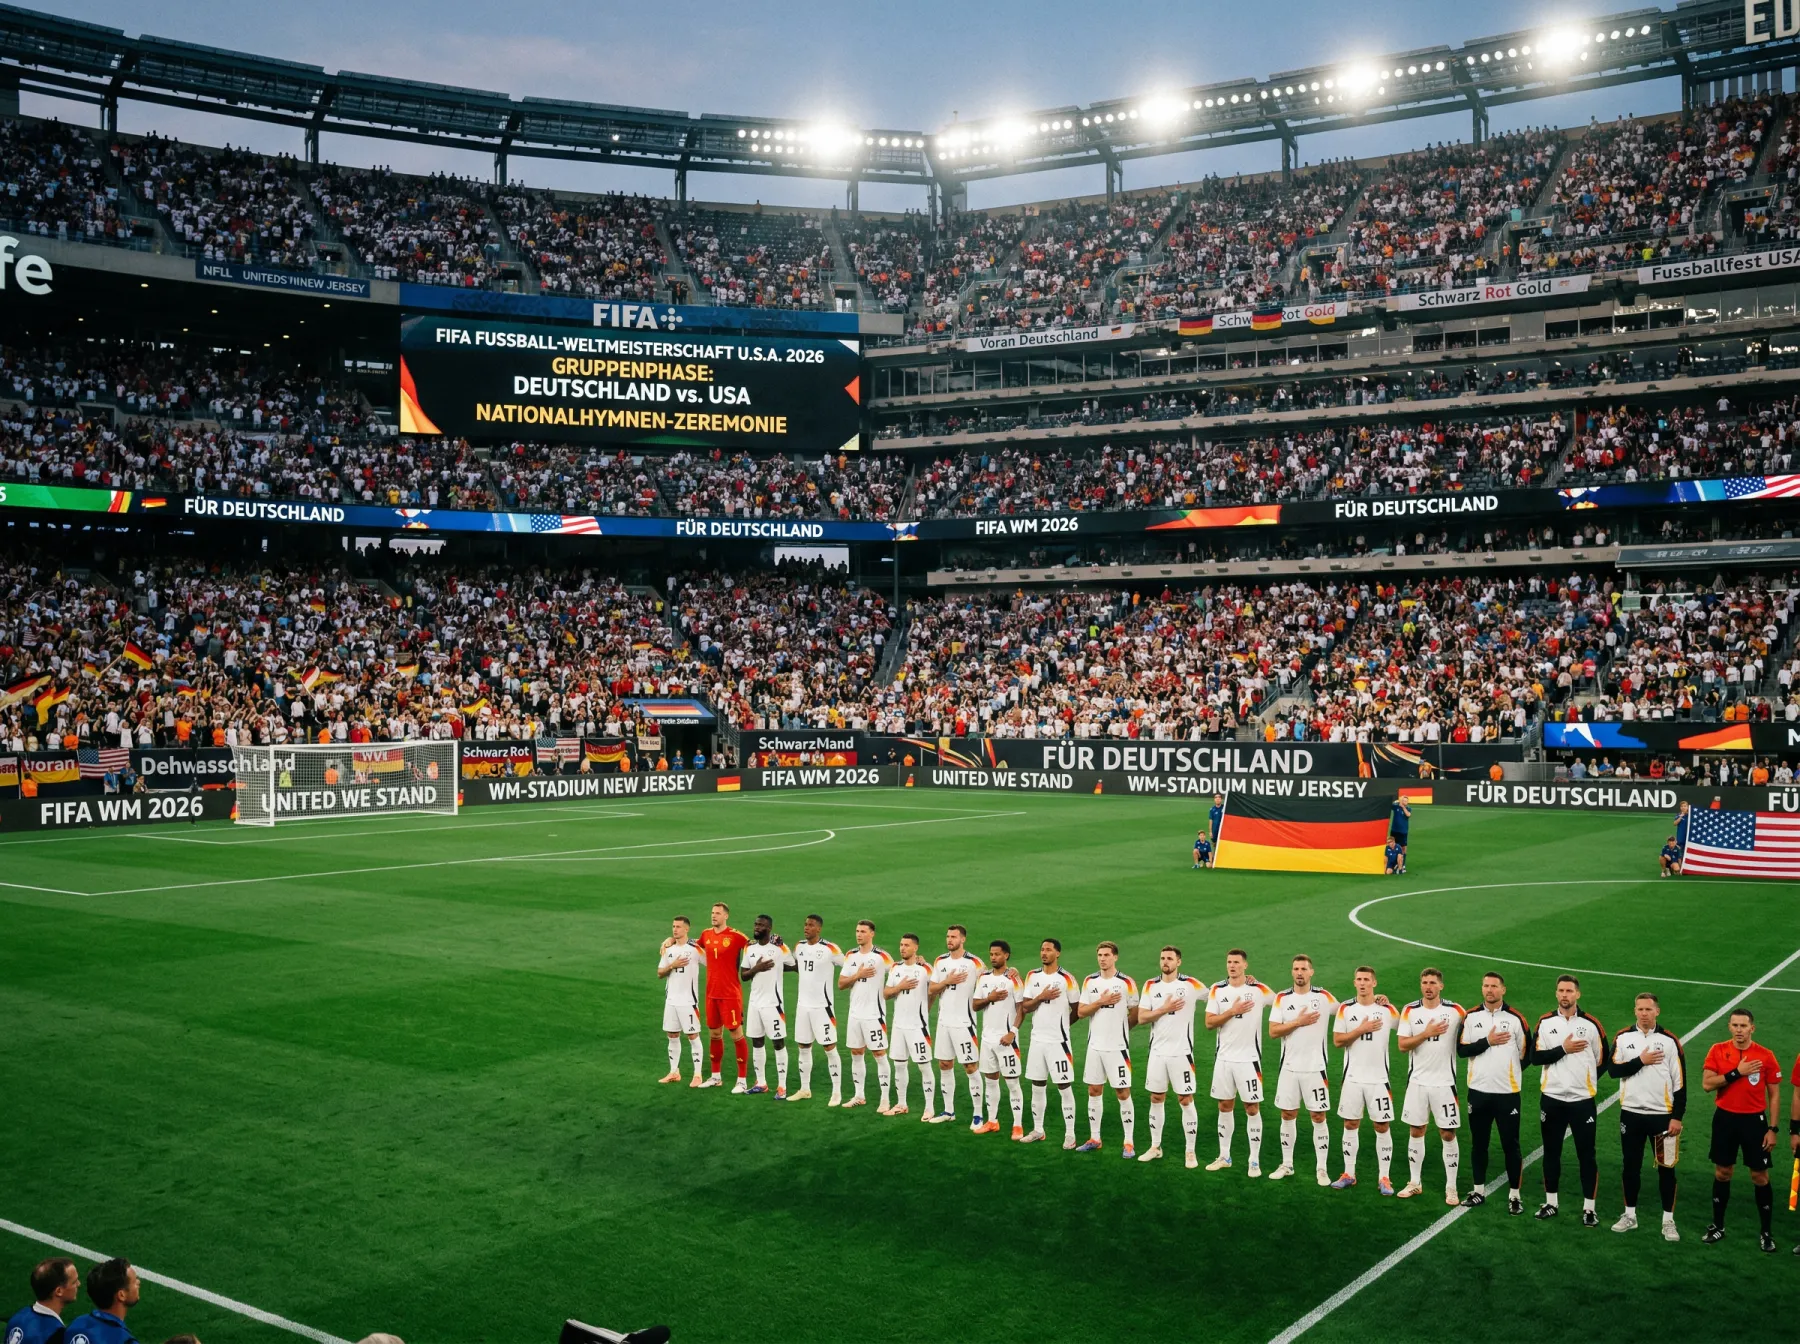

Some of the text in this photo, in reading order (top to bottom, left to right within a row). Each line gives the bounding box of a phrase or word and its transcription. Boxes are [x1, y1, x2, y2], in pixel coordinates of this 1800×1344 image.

[1652, 255, 1762, 281] Fussballfest
[326, 281, 365, 293] JERSEY
[1418, 279, 1552, 308] Schwarz Rot Gold
[593, 303, 658, 329] FIFA
[1219, 314, 1252, 327] Schw
[1304, 303, 1336, 317] Gold
[435, 327, 825, 364] FIFA FUSSBALL-WELTMEISTERSCHAFT U.S.A. 2026
[980, 328, 1098, 350] Voran Deutschland
[552, 357, 714, 382] GRUPPENPHASE:
[513, 375, 751, 406] DEUTSCHLAND vs. USA
[476, 403, 787, 434] NATIONALHYMNEN-ZEREMONIE
[184, 496, 345, 523] FÜR DEUTSCHLAND
[1335, 495, 1499, 518] FÜR DEUTSCHLAND
[676, 517, 824, 538] FÜR DEUTSCHLAND
[975, 516, 1079, 535] FIFA WM 2026
[463, 745, 530, 759] Schwarz Rot
[1043, 740, 1313, 775] FÜR DEUTSCHLAND
[489, 775, 695, 801] WM-STADIUM NEW JERSEY
[762, 768, 880, 787] FIFA WM 2026
[932, 770, 1073, 789] UNITED WE STAND
[1127, 775, 1367, 798] WM-STADIUM NEW JERSEY
[262, 785, 437, 813] UNITED WE STAND
[1466, 780, 1677, 809] FÜR DEUTSCHLAND
[40, 796, 204, 825] FIFA WM 2026
[1055, 1060, 1068, 1073] 10
[1118, 1066, 1125, 1078] 6
[1312, 1088, 1326, 1101] 13
[1375, 1097, 1389, 1111] 13
[1442, 1103, 1456, 1117] 13
